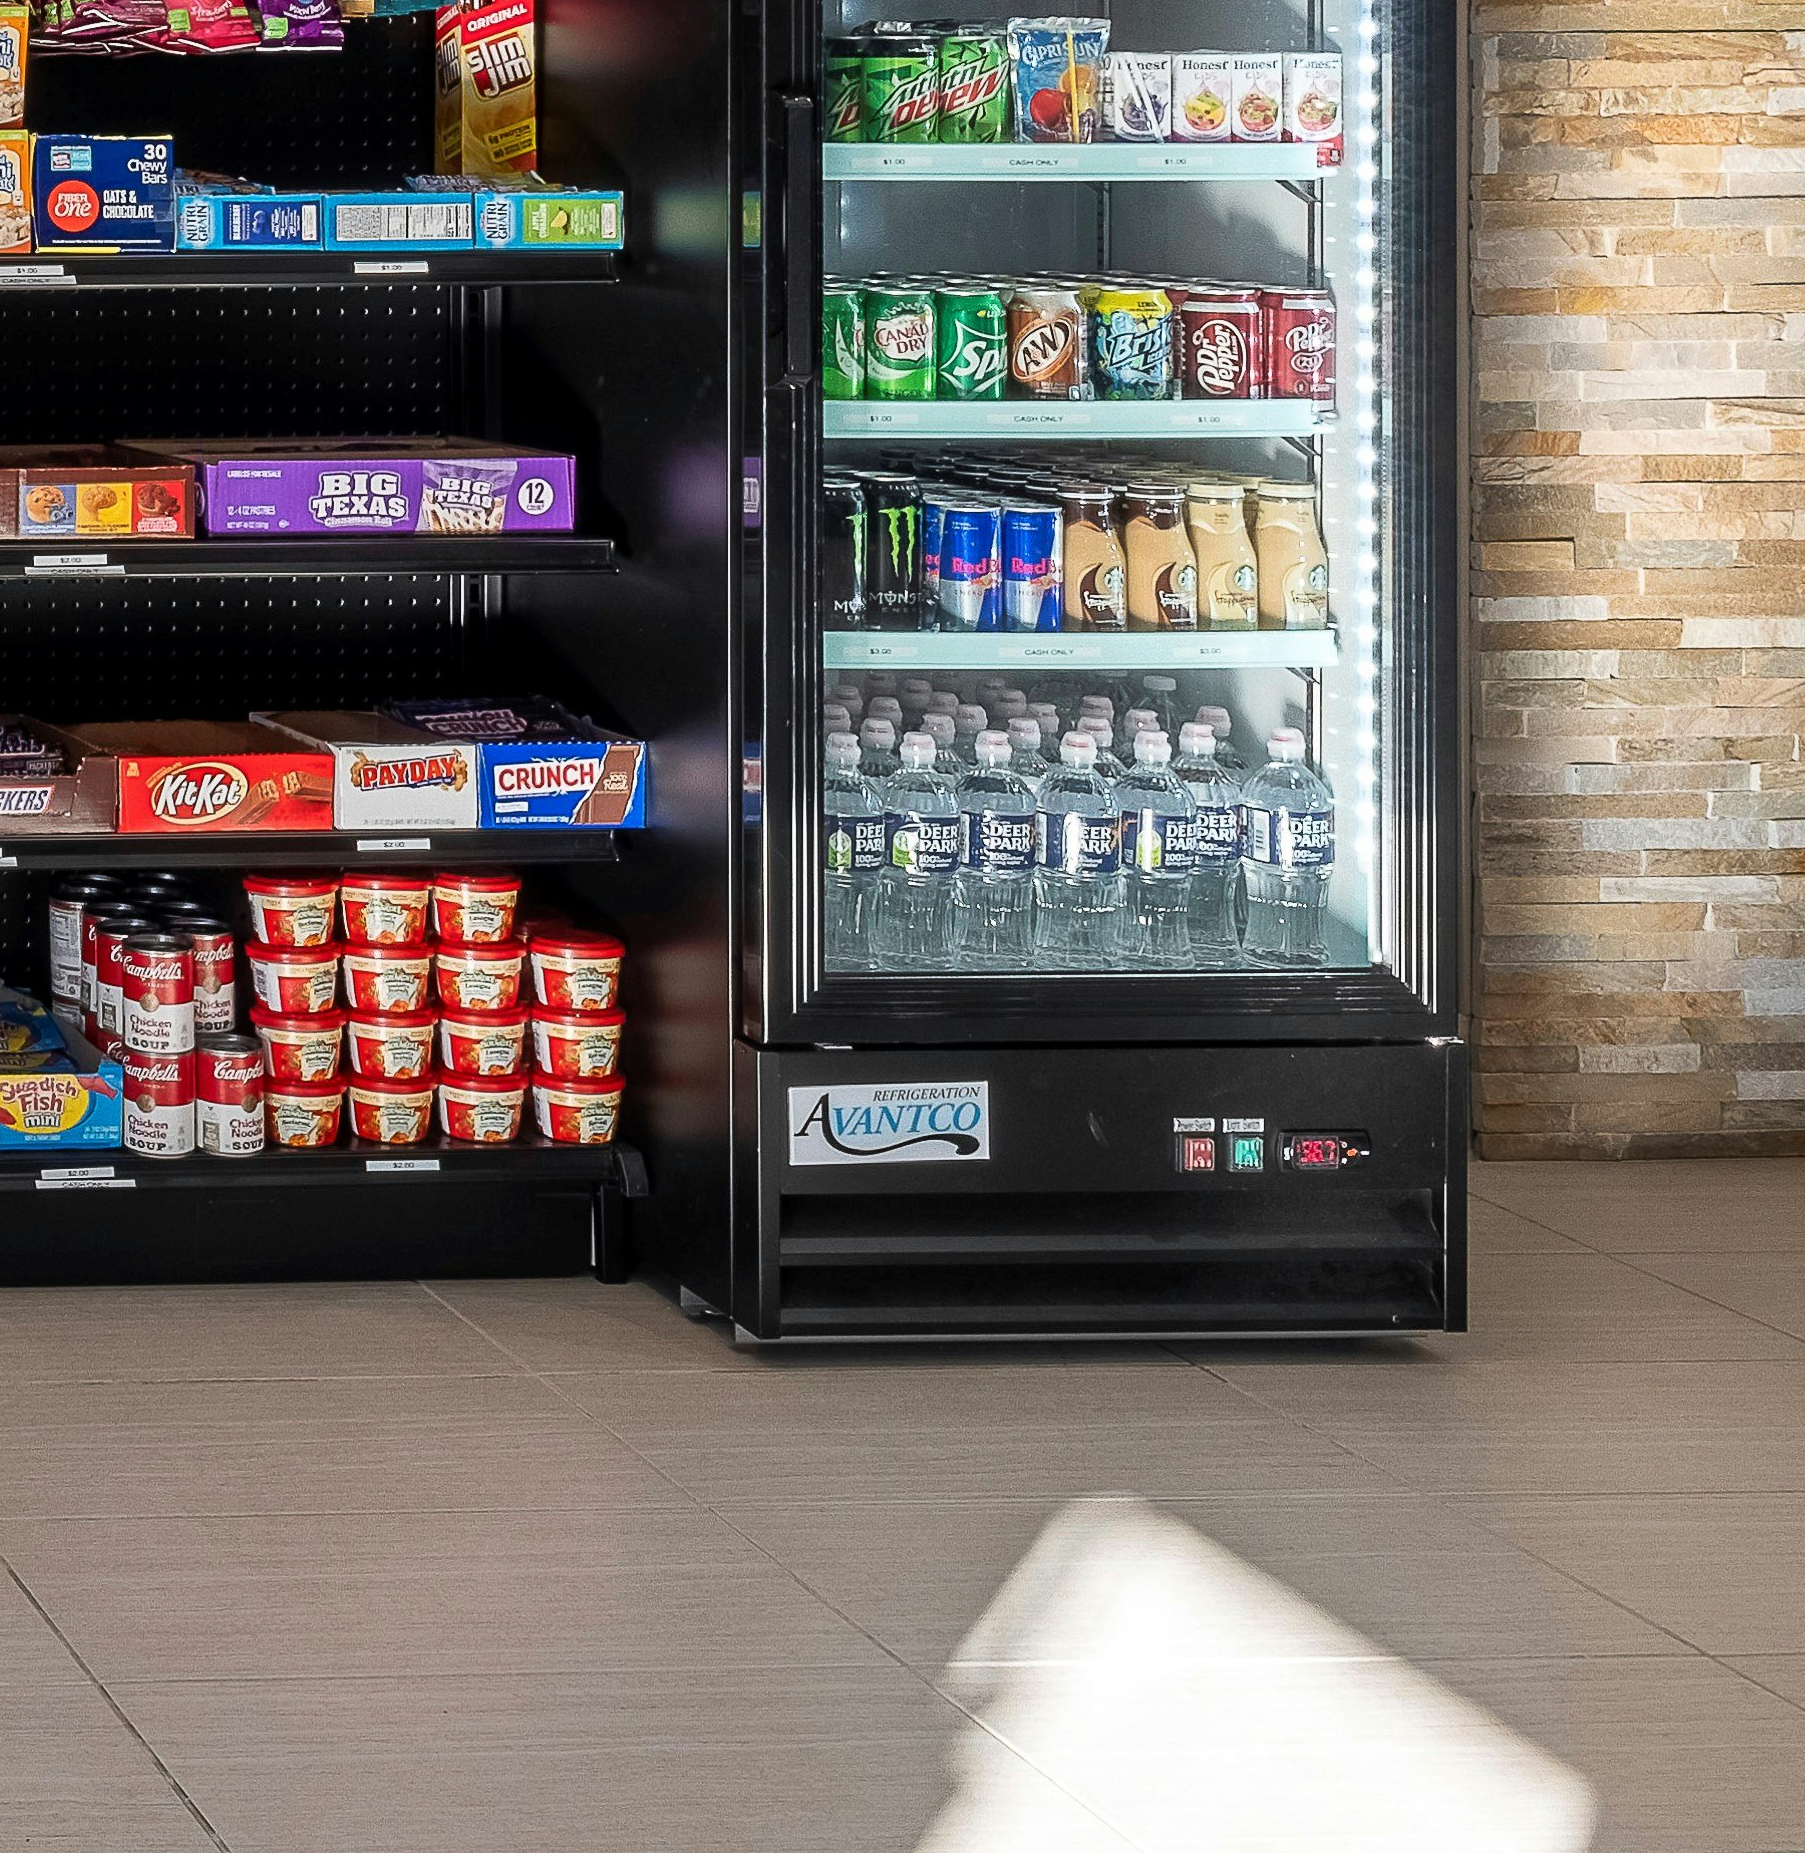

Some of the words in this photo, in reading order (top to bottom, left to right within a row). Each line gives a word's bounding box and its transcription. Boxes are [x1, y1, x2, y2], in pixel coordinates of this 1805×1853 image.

[467, 39, 524, 73] slim
[1181, 59, 1229, 71] Honest
[1234, 59, 1277, 71] Honest
[486, 56, 530, 96] jim
[144, 145, 167, 159] 30
[128, 159, 167, 173] Chewy
[142, 172, 167, 185] Bars
[58, 193, 88, 204] FIBER
[103, 191, 125, 204] OATS
[128, 191, 136, 204] &
[58, 200, 92, 218] One
[187, 204, 199, 243] NUTRI
[198, 206, 208, 244] GRAIN
[1019, 322, 1068, 373] A&W
[322, 473, 399, 496] BIG
[313, 497, 406, 518] TEXAS
[362, 759, 459, 789] PAYDAY
[497, 764, 595, 794] CRUNCH
[919, 823, 959, 840] DEER
[919, 838, 959, 855] PARK
[130, 1014, 172, 1028] Chicken
[132, 1026, 170, 1038] Noodle
[132, 1037, 170, 1050] SOUP
[873, 1085, 982, 1103] REFRIGERATION
[18, 1095, 64, 1114] Fish
[23, 1113, 61, 1128] mini
[794, 1092, 982, 1141] AVANTCO
